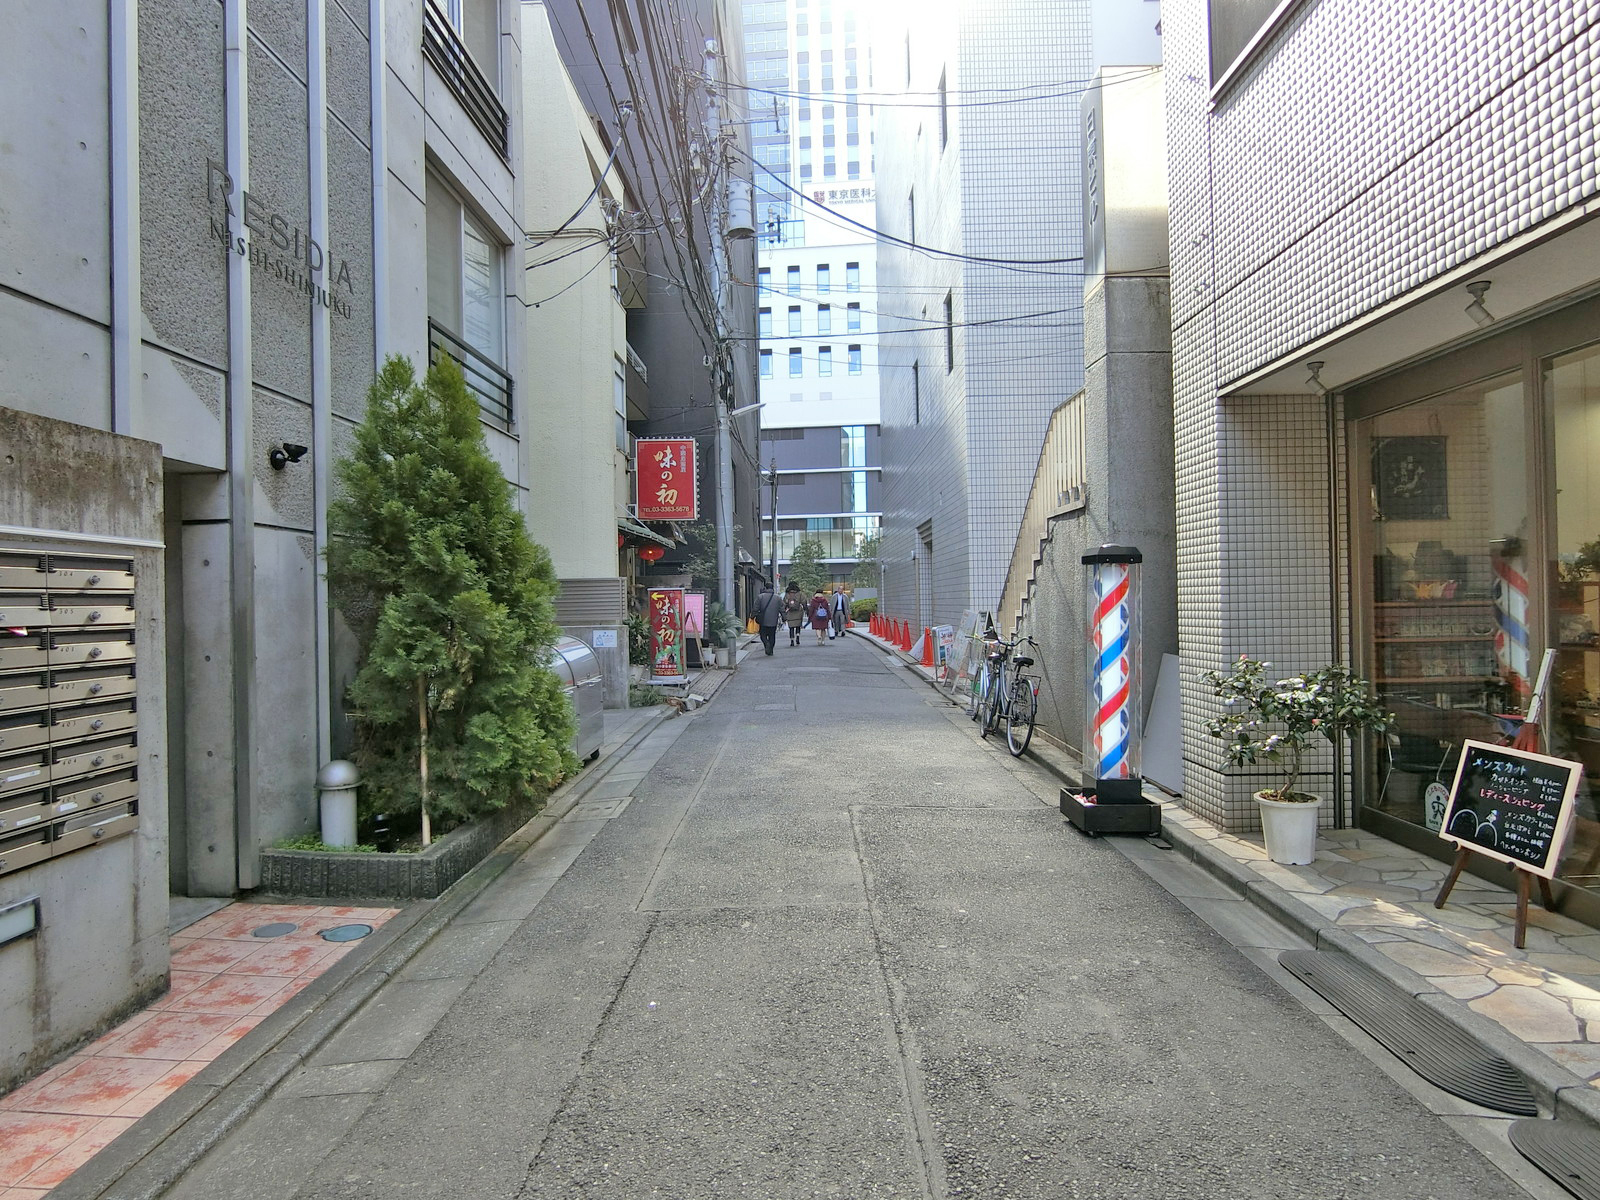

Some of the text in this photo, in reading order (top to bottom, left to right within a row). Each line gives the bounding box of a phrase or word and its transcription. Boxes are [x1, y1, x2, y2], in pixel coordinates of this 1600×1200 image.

[206, 157, 353, 295] RESIDIA
[210, 216, 351, 319] NISHI-SHINJUKU
[653, 445, 678, 506] 味の初
[1472, 757, 1527, 776] メンズカット
